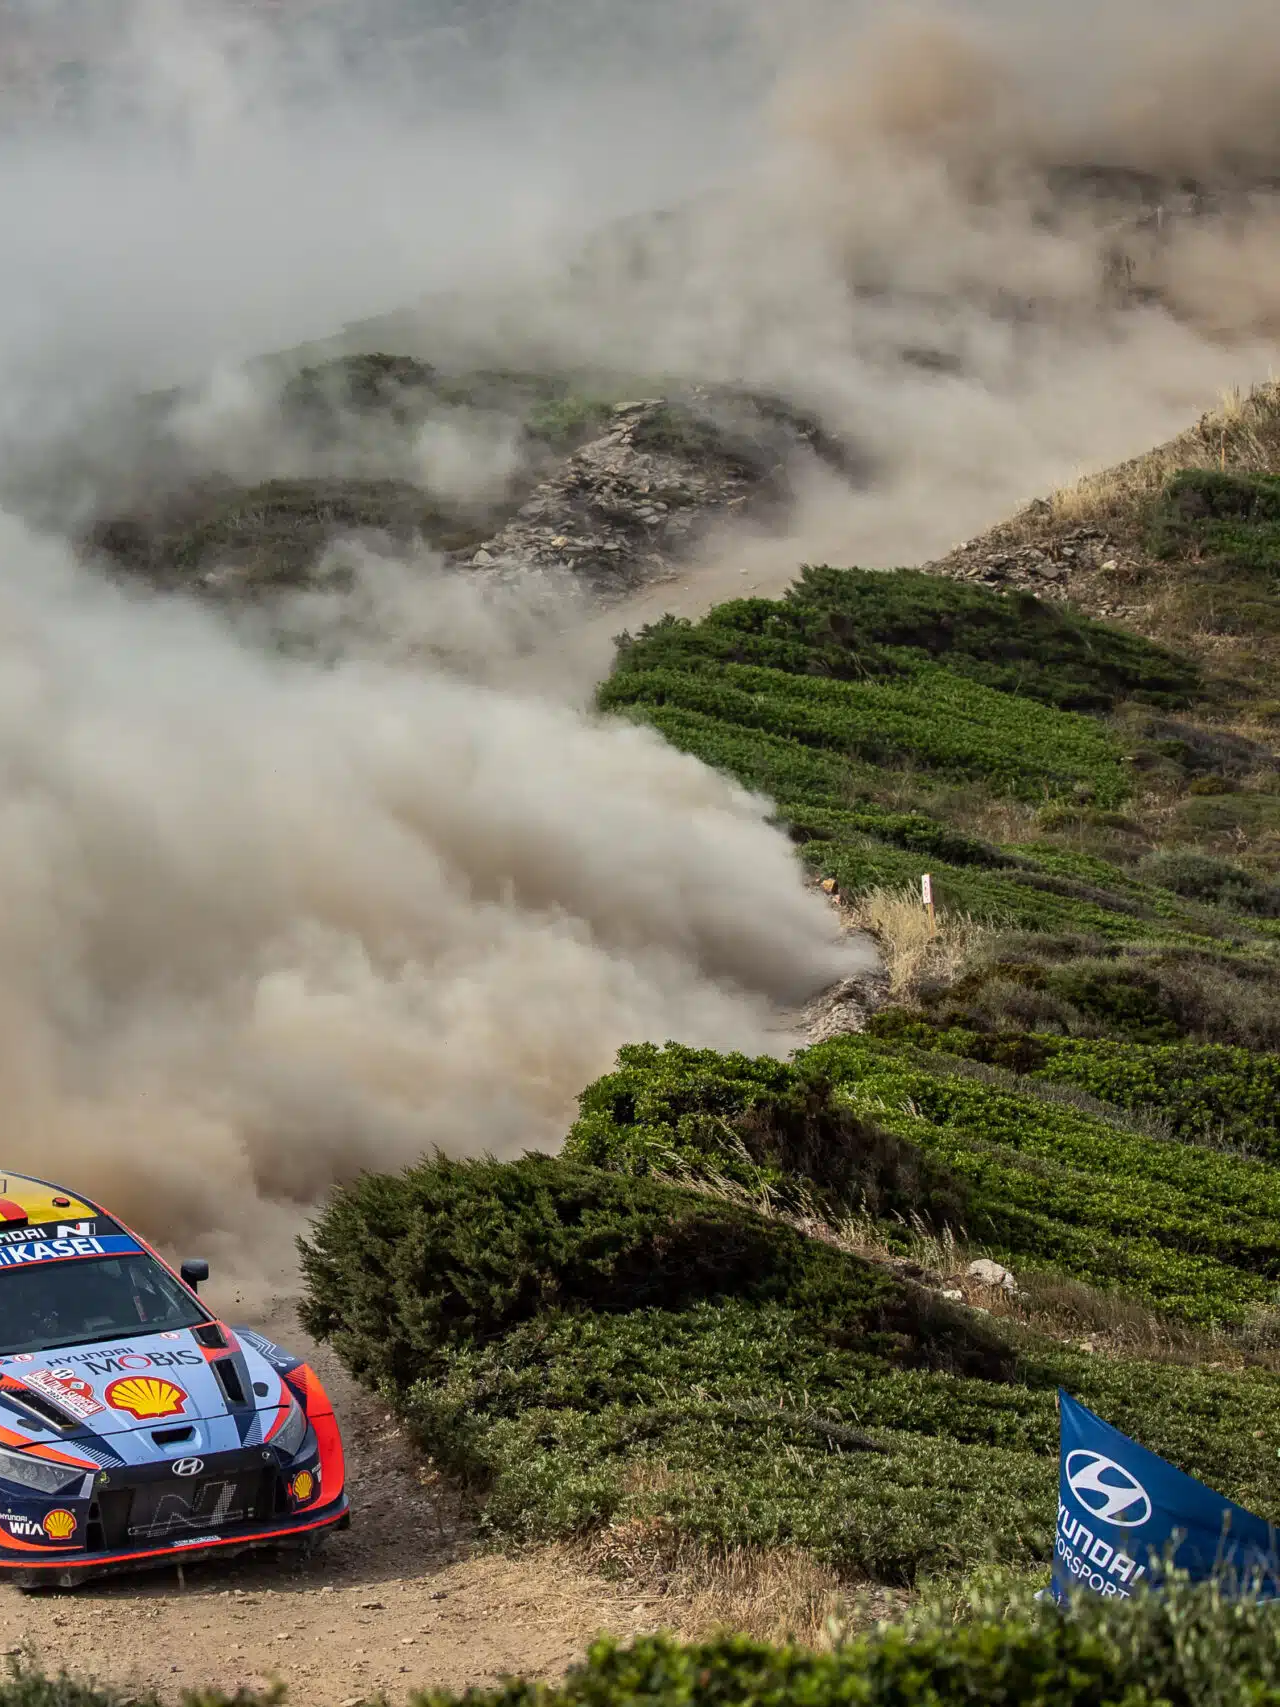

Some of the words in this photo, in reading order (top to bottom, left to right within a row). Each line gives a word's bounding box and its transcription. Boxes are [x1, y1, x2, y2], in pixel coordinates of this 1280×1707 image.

[46, 1347, 135, 1366] HYUNDAI
[83, 1350, 204, 1376] MOBIS
[54, 1369, 73, 1379] 11
[0, 1512, 28, 1522] HYUNDAI
[9, 1520, 45, 1536] WIA
[1058, 1497, 1146, 1588] YUNDAI
